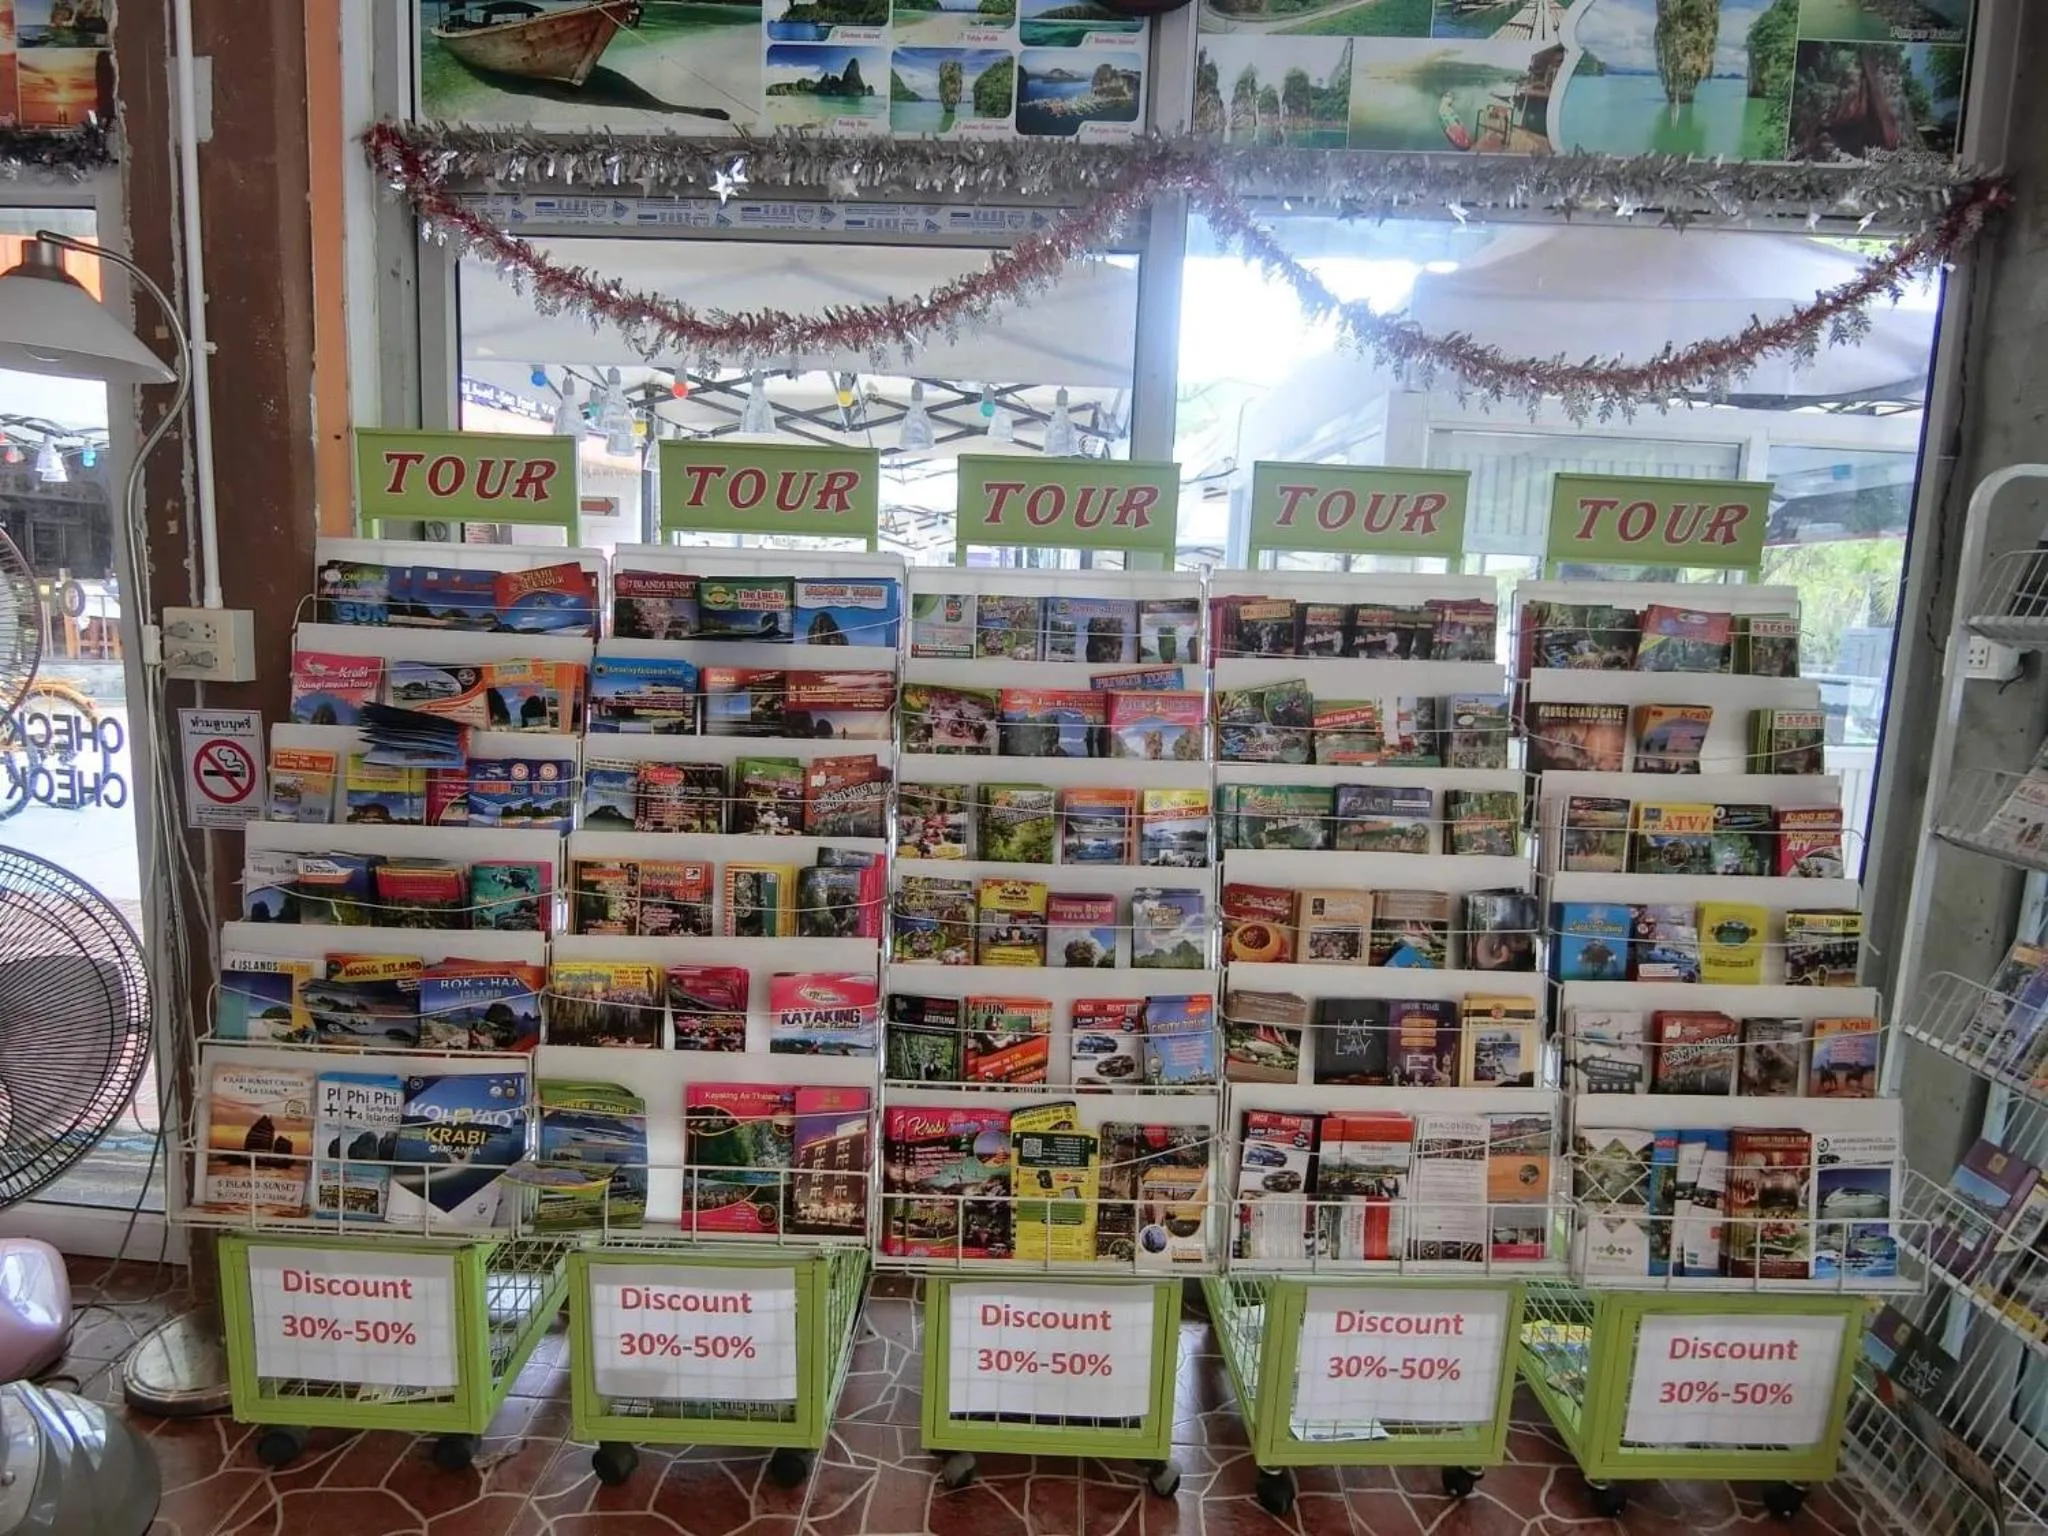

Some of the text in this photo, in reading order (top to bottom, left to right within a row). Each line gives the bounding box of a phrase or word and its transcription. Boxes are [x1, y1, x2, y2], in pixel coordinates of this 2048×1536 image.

[383, 451, 559, 502] TOUR
[684, 464, 861, 513] TOUR
[983, 481, 1160, 529] TOUR
[1275, 485, 1450, 535] TOUR
[1577, 497, 1751, 546] TOUR
[634, 581, 664, 590] ISLANDS
[665, 581, 696, 590] SUNSET
[754, 589, 785, 602] Lucky
[338, 603, 387, 623] SUN
[1600, 707, 1625, 719] CAVE
[1788, 840, 1812, 851] ATV
[1050, 902, 1113, 914] James Bond
[230, 961, 237, 971] 4
[238, 961, 279, 973] ISLANDS
[345, 960, 423, 979] HONG ISLAND
[440, 978, 472, 990] ROK
[490, 977, 521, 988] HAA
[780, 1008, 862, 1027] KAYAKING
[1841, 1020, 1873, 1030] Krabi
[1335, 1039, 1372, 1056] LAY
[347, 1090, 370, 1104] Phi
[374, 1091, 397, 1105] Phi
[704, 1091, 738, 1102] Kayaking
[356, 1112, 363, 1120] 4
[366, 1113, 400, 1124] islands
[424, 1126, 488, 1145] KRABI
[263, 1182, 296, 1191] SUNSET
[282, 1268, 413, 1300] Discount
[620, 1287, 752, 1315] Discount
[979, 1303, 1112, 1332] Discount
[1334, 1309, 1464, 1336] Discount
[282, 1314, 416, 1347] 30%-50%
[620, 1332, 757, 1360] 30%-50%
[1669, 1335, 1798, 1361] Discount
[976, 1348, 1113, 1377] 30%-50%
[1327, 1355, 1461, 1382] 30%-50%
[1659, 1378, 1794, 1407] 30%-50%
